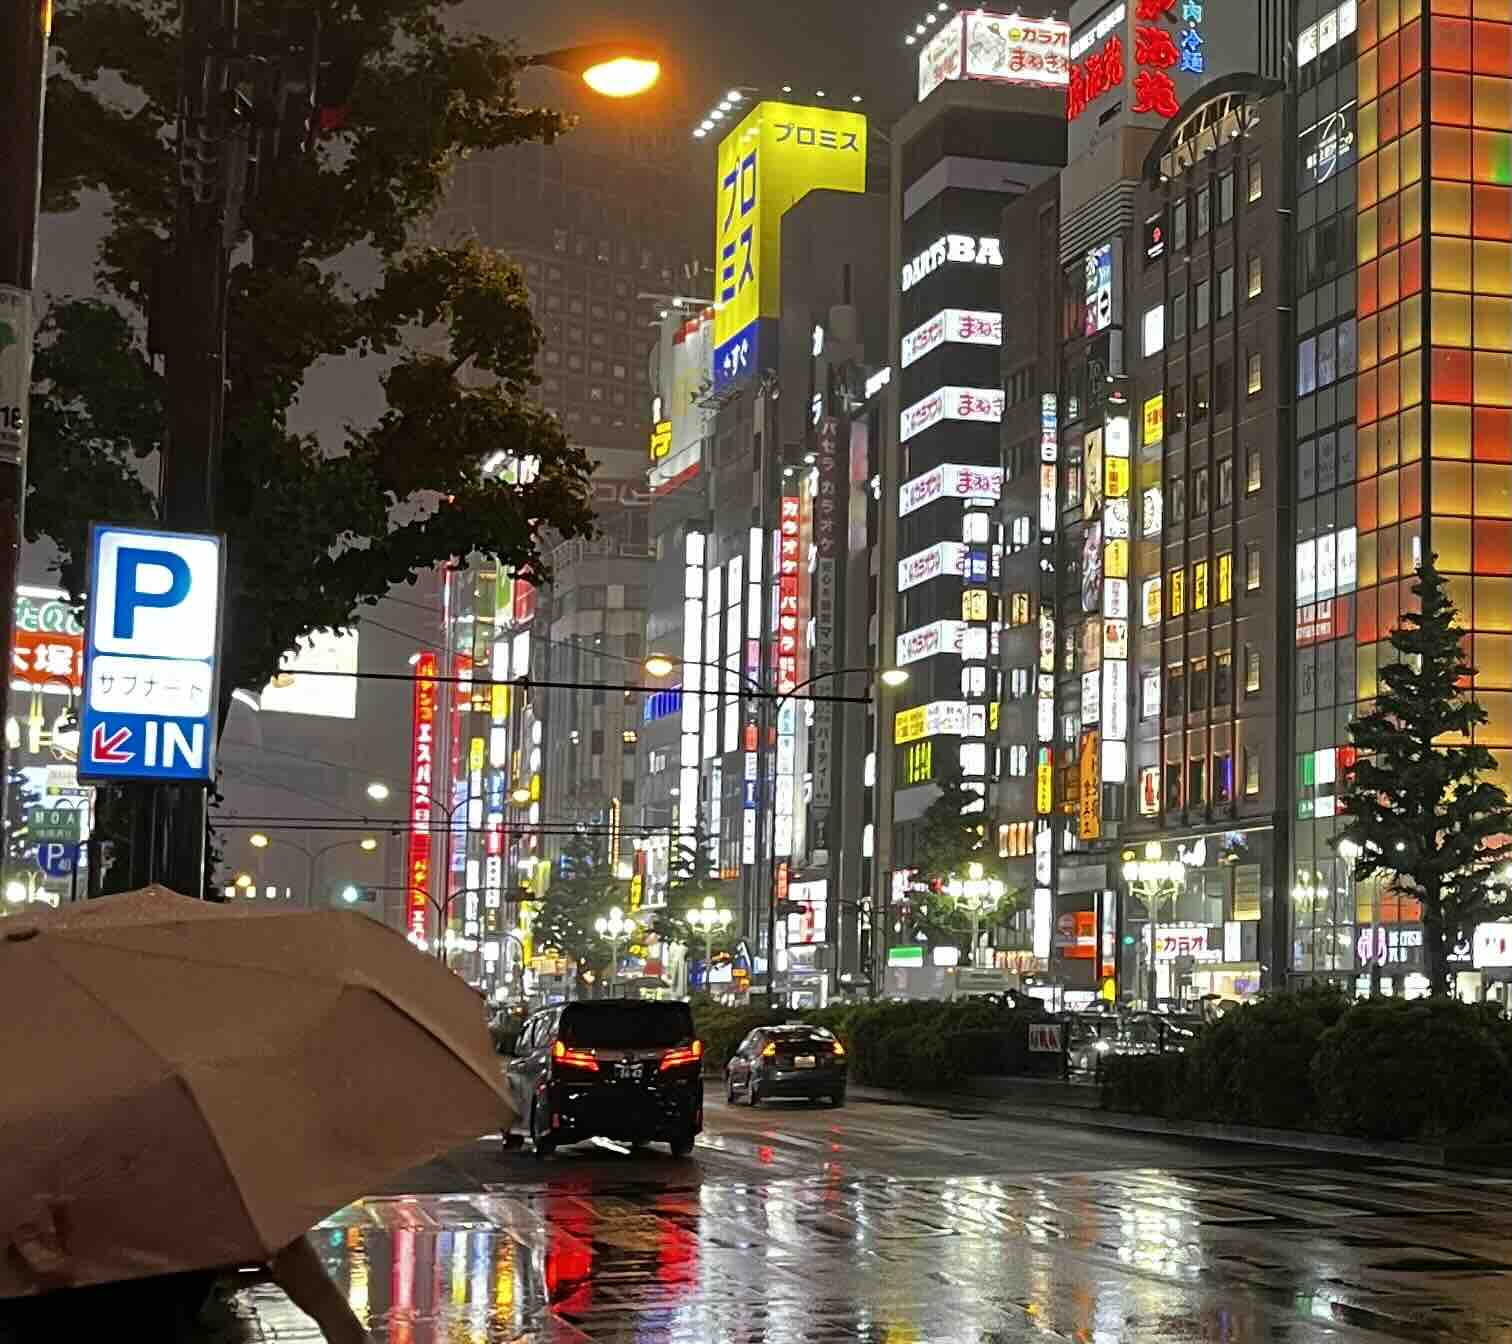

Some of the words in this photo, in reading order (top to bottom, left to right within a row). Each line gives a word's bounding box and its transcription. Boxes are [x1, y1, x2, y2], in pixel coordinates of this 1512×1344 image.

[773, 121, 860, 153] プロミス
[112, 546, 192, 640] P
[143, 720, 205, 769] IN
